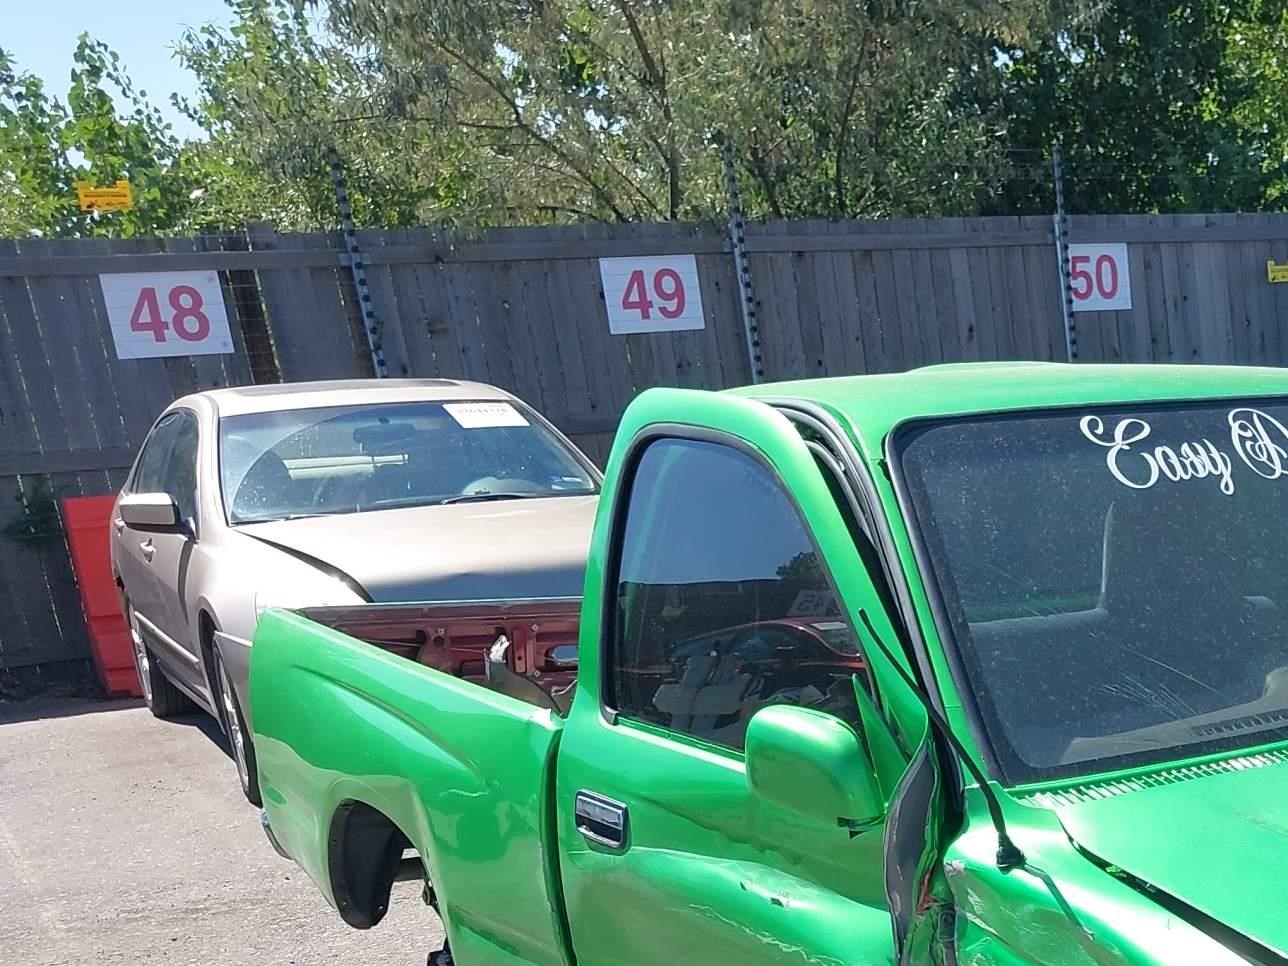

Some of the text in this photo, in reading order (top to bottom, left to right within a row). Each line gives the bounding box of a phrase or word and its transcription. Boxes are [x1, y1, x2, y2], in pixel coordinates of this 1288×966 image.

[622, 268, 686, 320] 49
[1071, 254, 1118, 300] 50
[130, 285, 210, 342] 48
[1079, 415, 1235, 495] Easy
